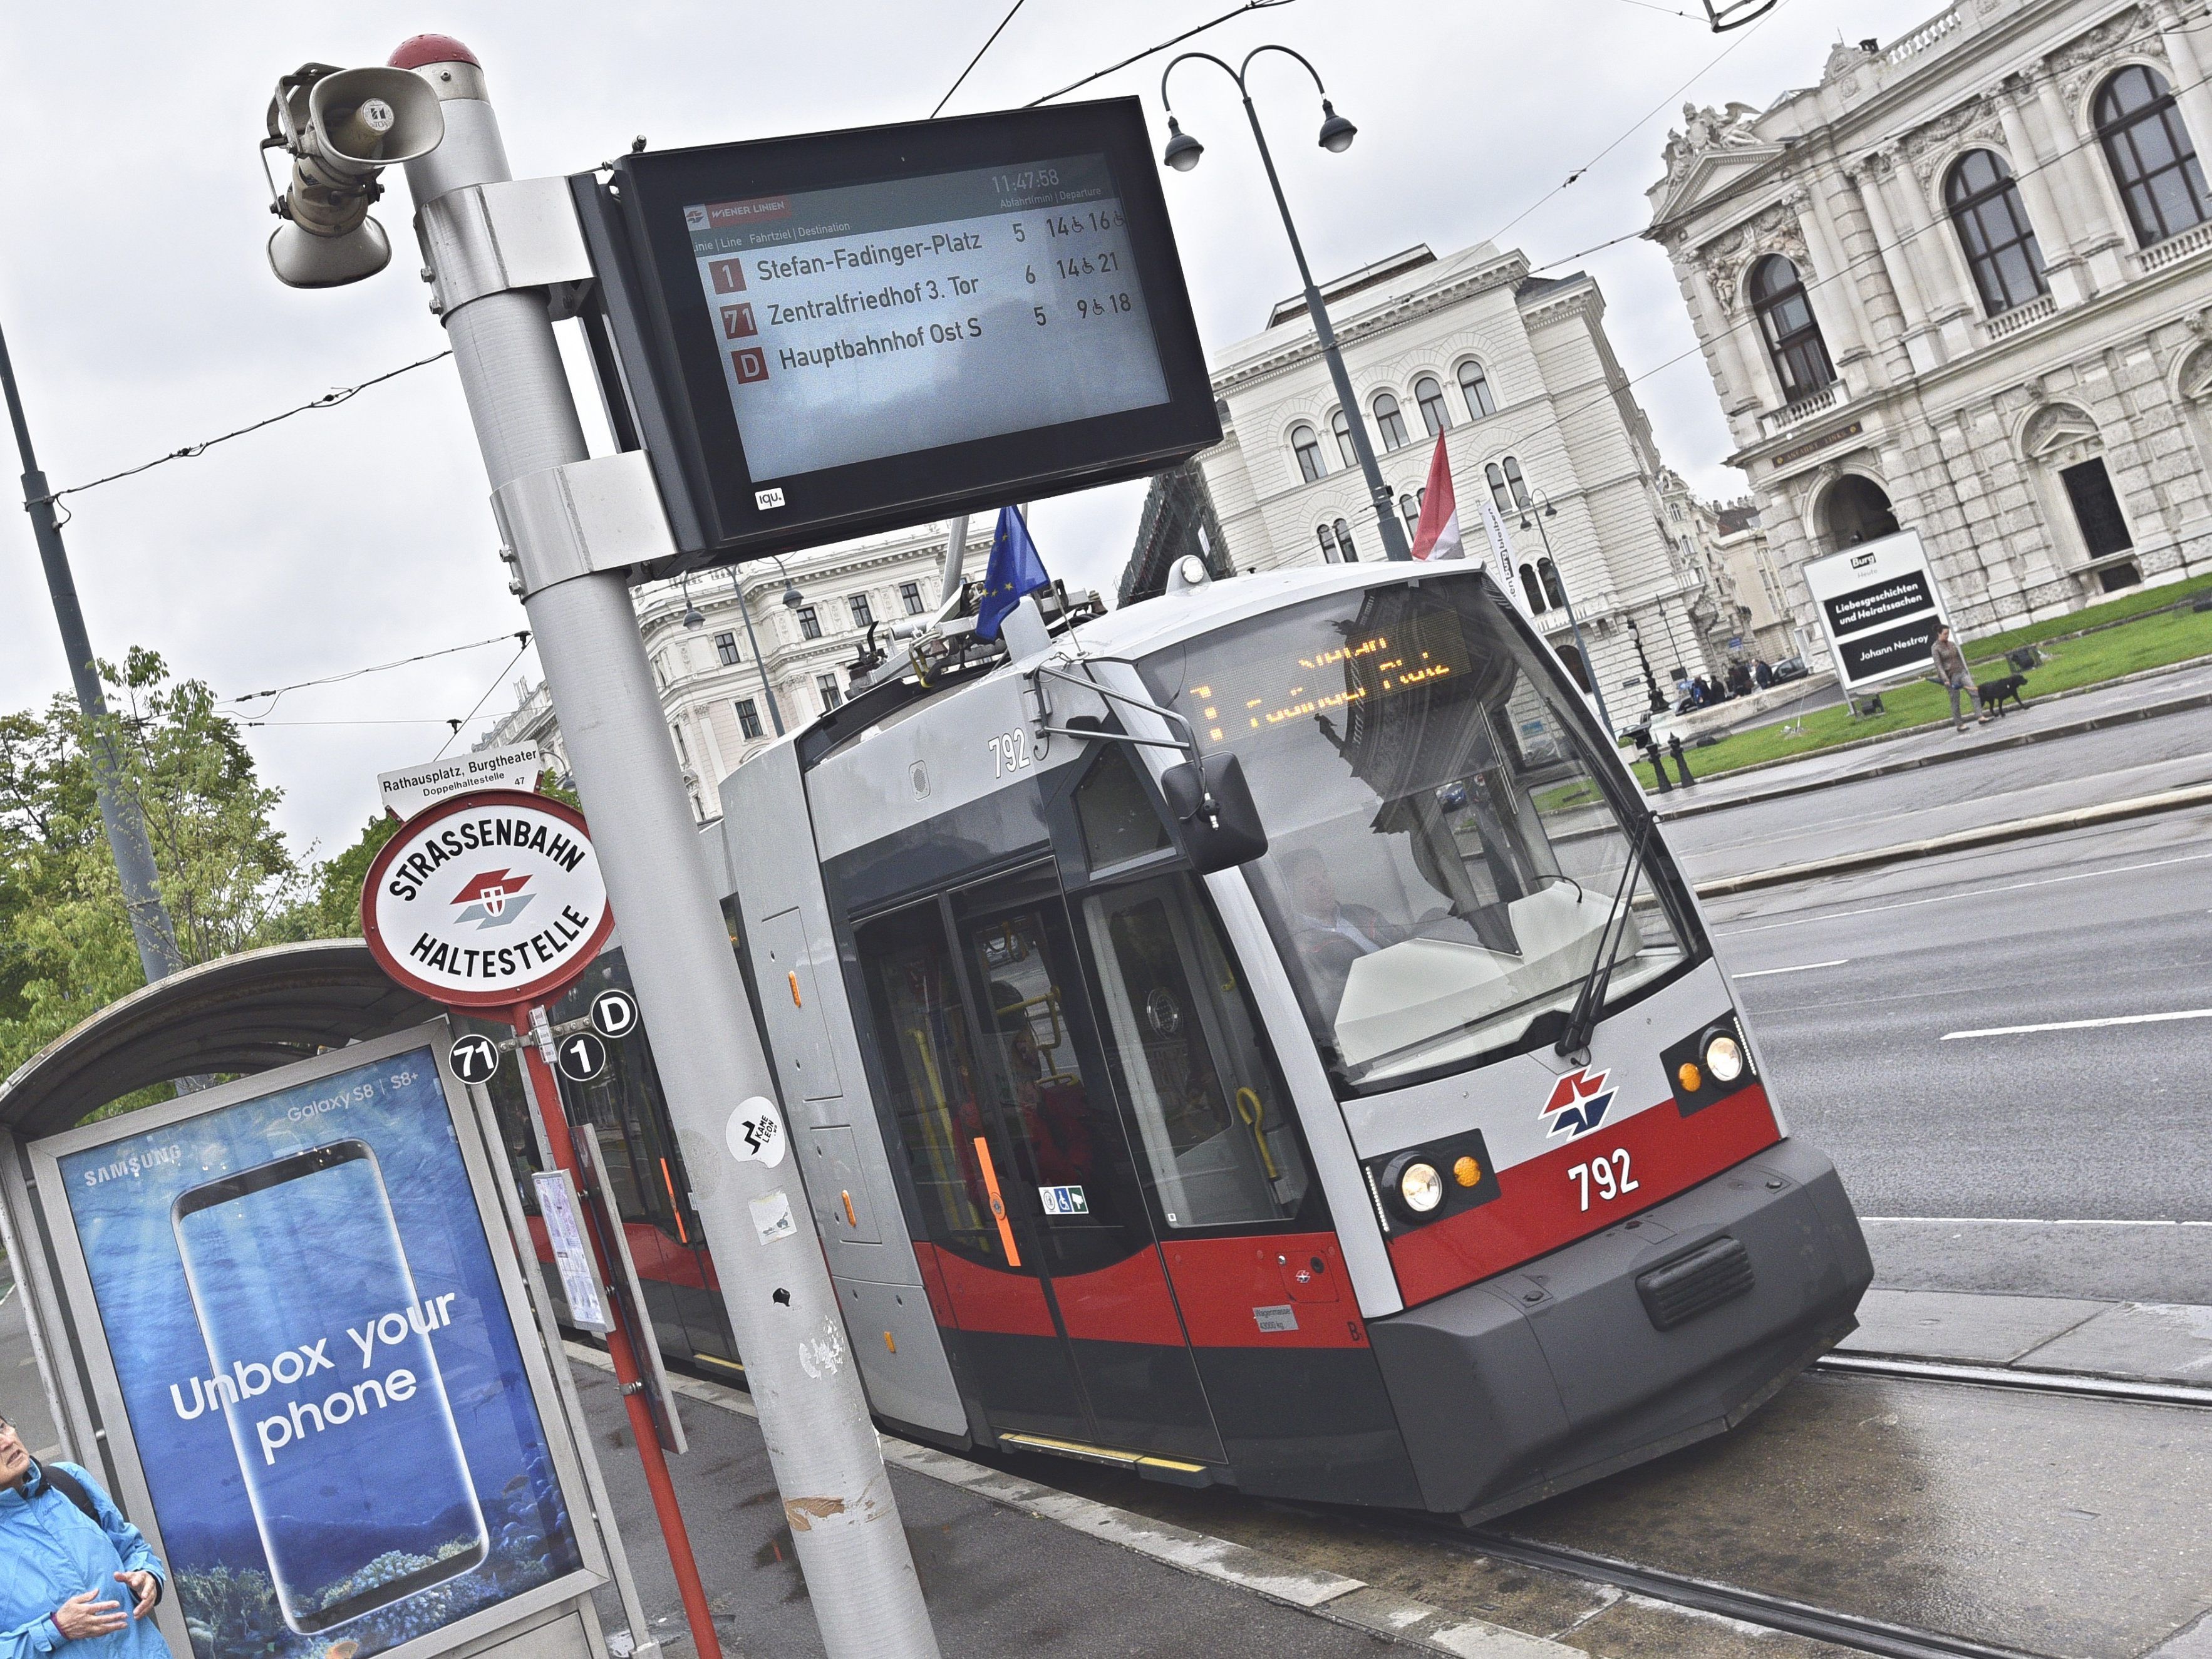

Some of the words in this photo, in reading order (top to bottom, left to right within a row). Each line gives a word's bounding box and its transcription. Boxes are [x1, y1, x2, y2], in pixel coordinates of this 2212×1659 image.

[992, 169, 1060, 193] 11:47:58
[1000, 193, 1053, 209] Abfahrt(min)
[1060, 187, 1102, 201] Departure
[711, 205, 752, 219] WIENER
[752, 200, 785, 214] LINIEN
[693, 240, 714, 252] inie
[720, 237, 743, 249] Line
[721, 264, 734, 288] 1
[757, 231, 983, 281] Stefan-Fadinger-Platz
[1012, 223, 1026, 242] 5
[1047, 216, 1069, 238] 14
[1088, 210, 1110, 232] 16
[749, 230, 792, 245] Fahrtziel
[798, 221, 851, 238] Destination
[723, 307, 755, 334] 71
[767, 282, 922, 326] Zentralfriedhof
[926, 280, 946, 300] 3.
[948, 275, 979, 296] Tor
[1025, 265, 1036, 284] 6
[1057, 258, 1080, 279] 14
[1098, 251, 1119, 273] 21
[740, 353, 761, 378] D
[779, 326, 925, 370] Hauptbahnhof
[929, 321, 964, 344] Ost
[967, 318, 983, 337] S
[1033, 306, 1047, 326] 5
[1077, 299, 1088, 319] 9
[1109, 292, 1132, 314] 18
[1488, 508, 1506, 550] bleiben
[1851, 554, 1876, 568] Burg
[1835, 582, 1919, 614] Liebesgeschichten
[1839, 611, 1858, 626] und
[1858, 594, 1923, 620] Heiratssachen
[1859, 644, 1893, 662] Johann
[1893, 634, 1930, 651] Nestroy
[383, 765, 465, 793] Rathausplatz,
[468, 750, 538, 774] Burgtheater
[988, 726, 1031, 780] 792
[423, 772, 505, 797] Doppelhaltestelle
[514, 777, 525, 786] 47
[389, 819, 586, 902] STRASSENBAHN
[410, 904, 589, 978] HALTESTELLE
[599, 996, 631, 1033] D
[453, 1040, 495, 1078] 71
[570, 1038, 592, 1074] 1
[287, 1092, 351, 1122] Galaxy
[353, 1083, 374, 1101] S8
[390, 1072, 419, 1089] S8+
[755, 1115, 768, 1139] KAME
[762, 1119, 774, 1144] LEON
[84, 1144, 182, 1187] SAMSUNG
[1567, 1147, 1640, 1212] 792
[169, 1337, 336, 1421] Unbox
[346, 1291, 456, 1370] your
[256, 1368, 418, 1465] phone
